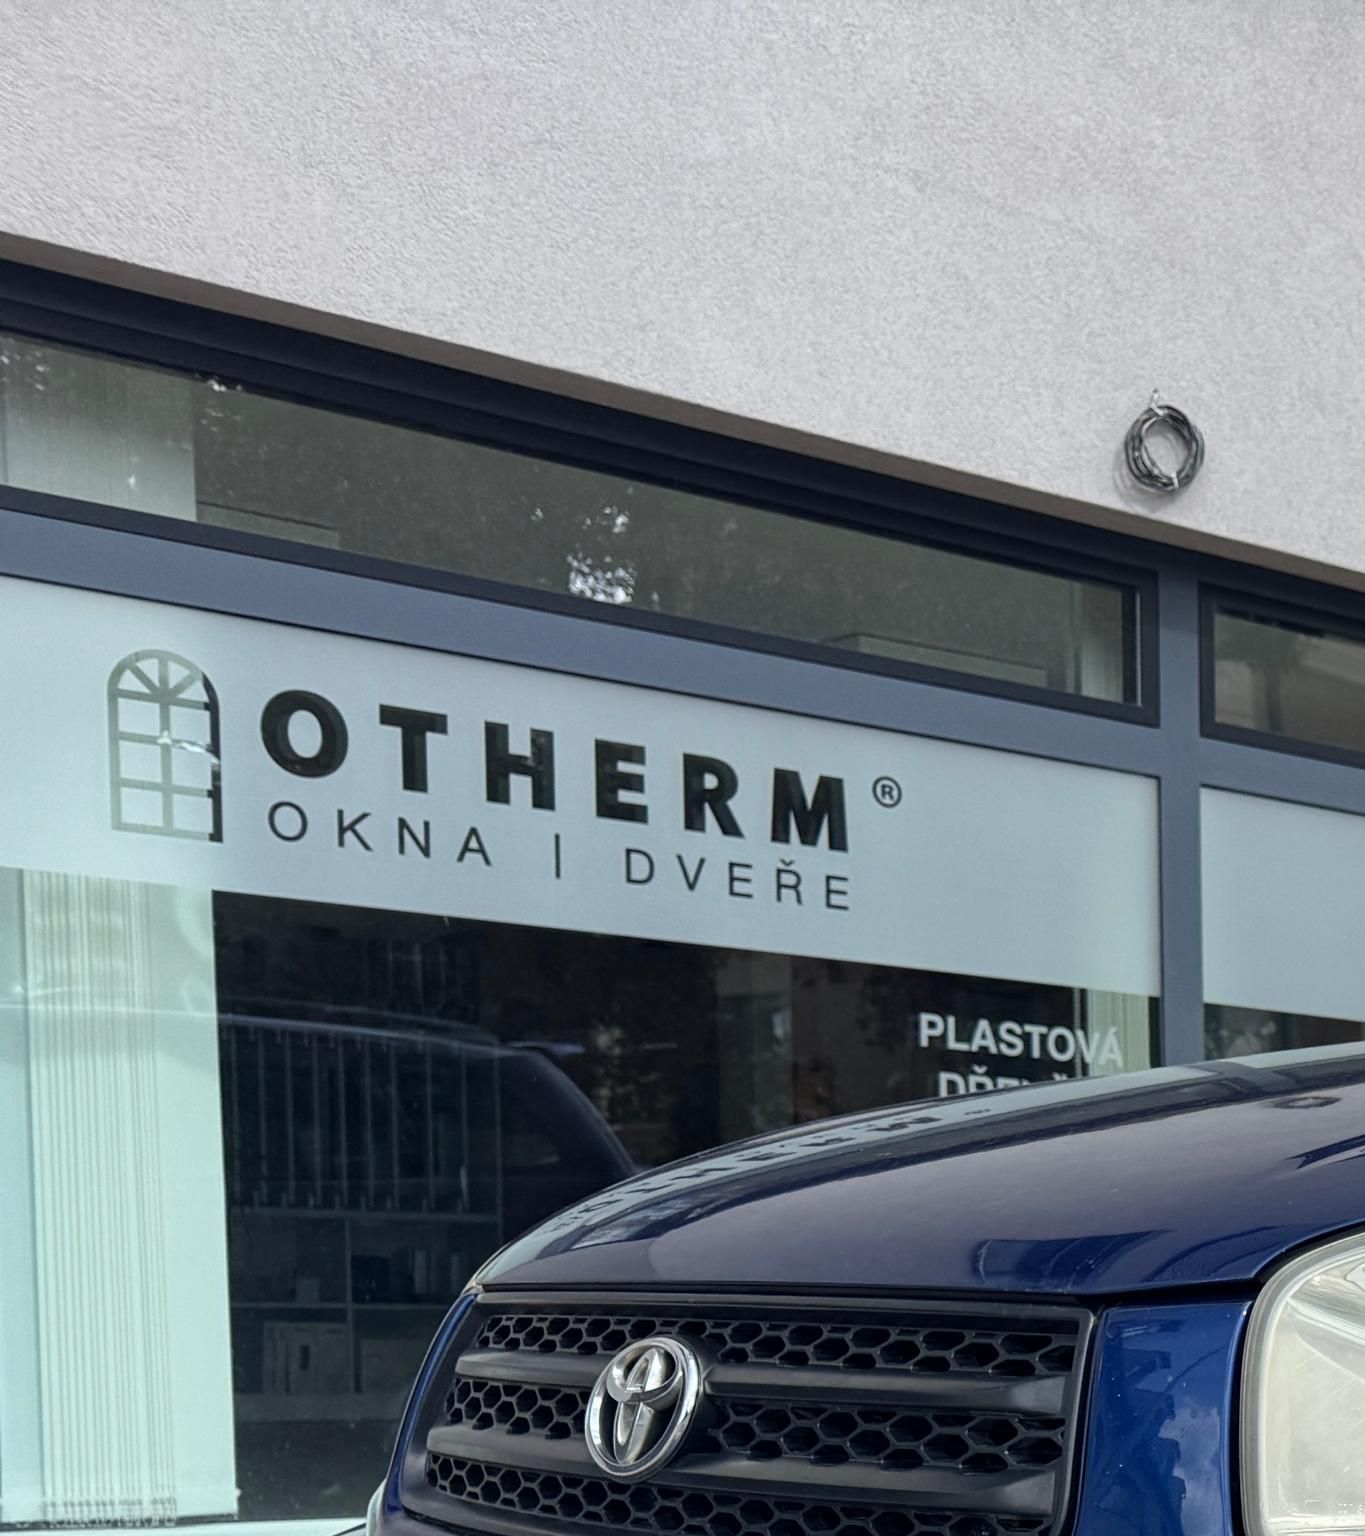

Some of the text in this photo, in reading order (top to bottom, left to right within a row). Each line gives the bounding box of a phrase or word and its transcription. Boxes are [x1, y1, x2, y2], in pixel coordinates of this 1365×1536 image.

[267, 801, 492, 867] OKNA
[625, 847, 851, 911] DVEŘE
[918, 1011, 1124, 1069] PLASTOVÁ
